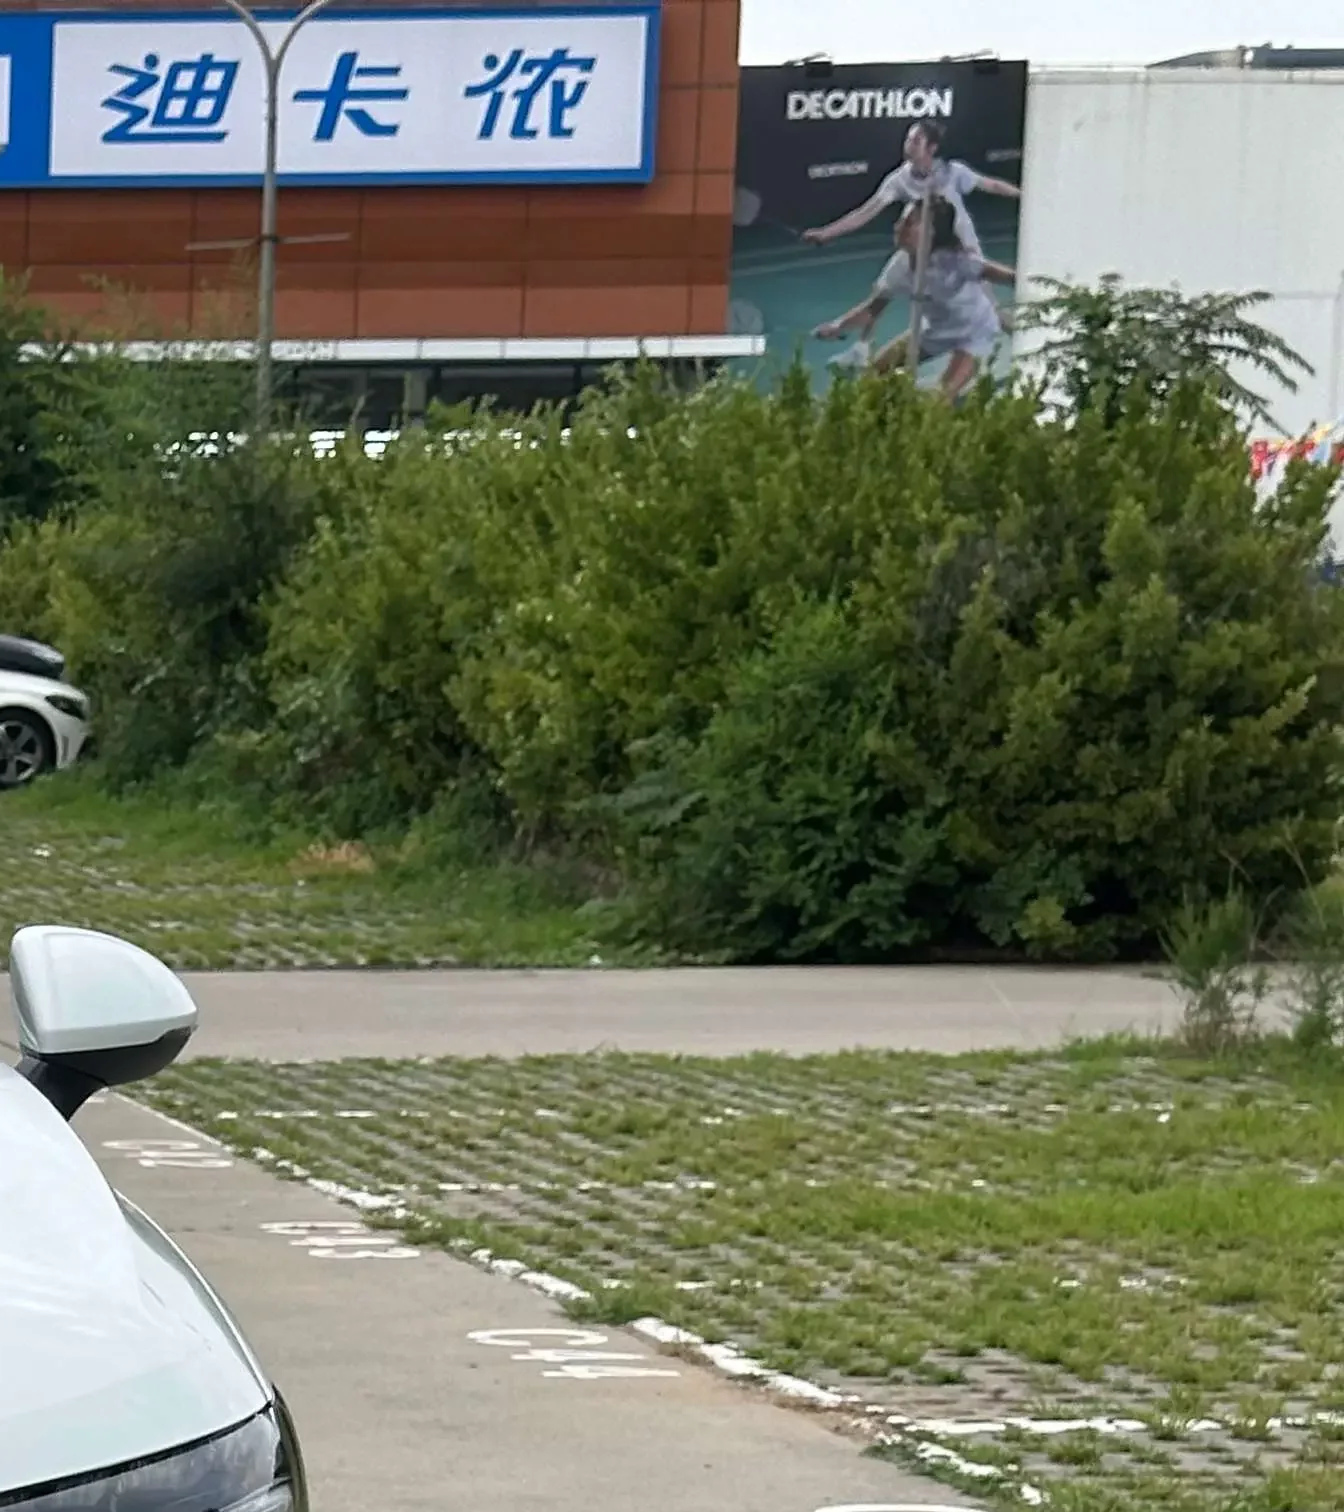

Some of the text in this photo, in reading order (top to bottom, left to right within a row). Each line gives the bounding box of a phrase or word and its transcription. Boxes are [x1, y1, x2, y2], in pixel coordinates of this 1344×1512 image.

[102, 48, 597, 143] 迪卡侬
[787, 88, 953, 120] DECATHLON
[466, 1326, 681, 1380] C44
